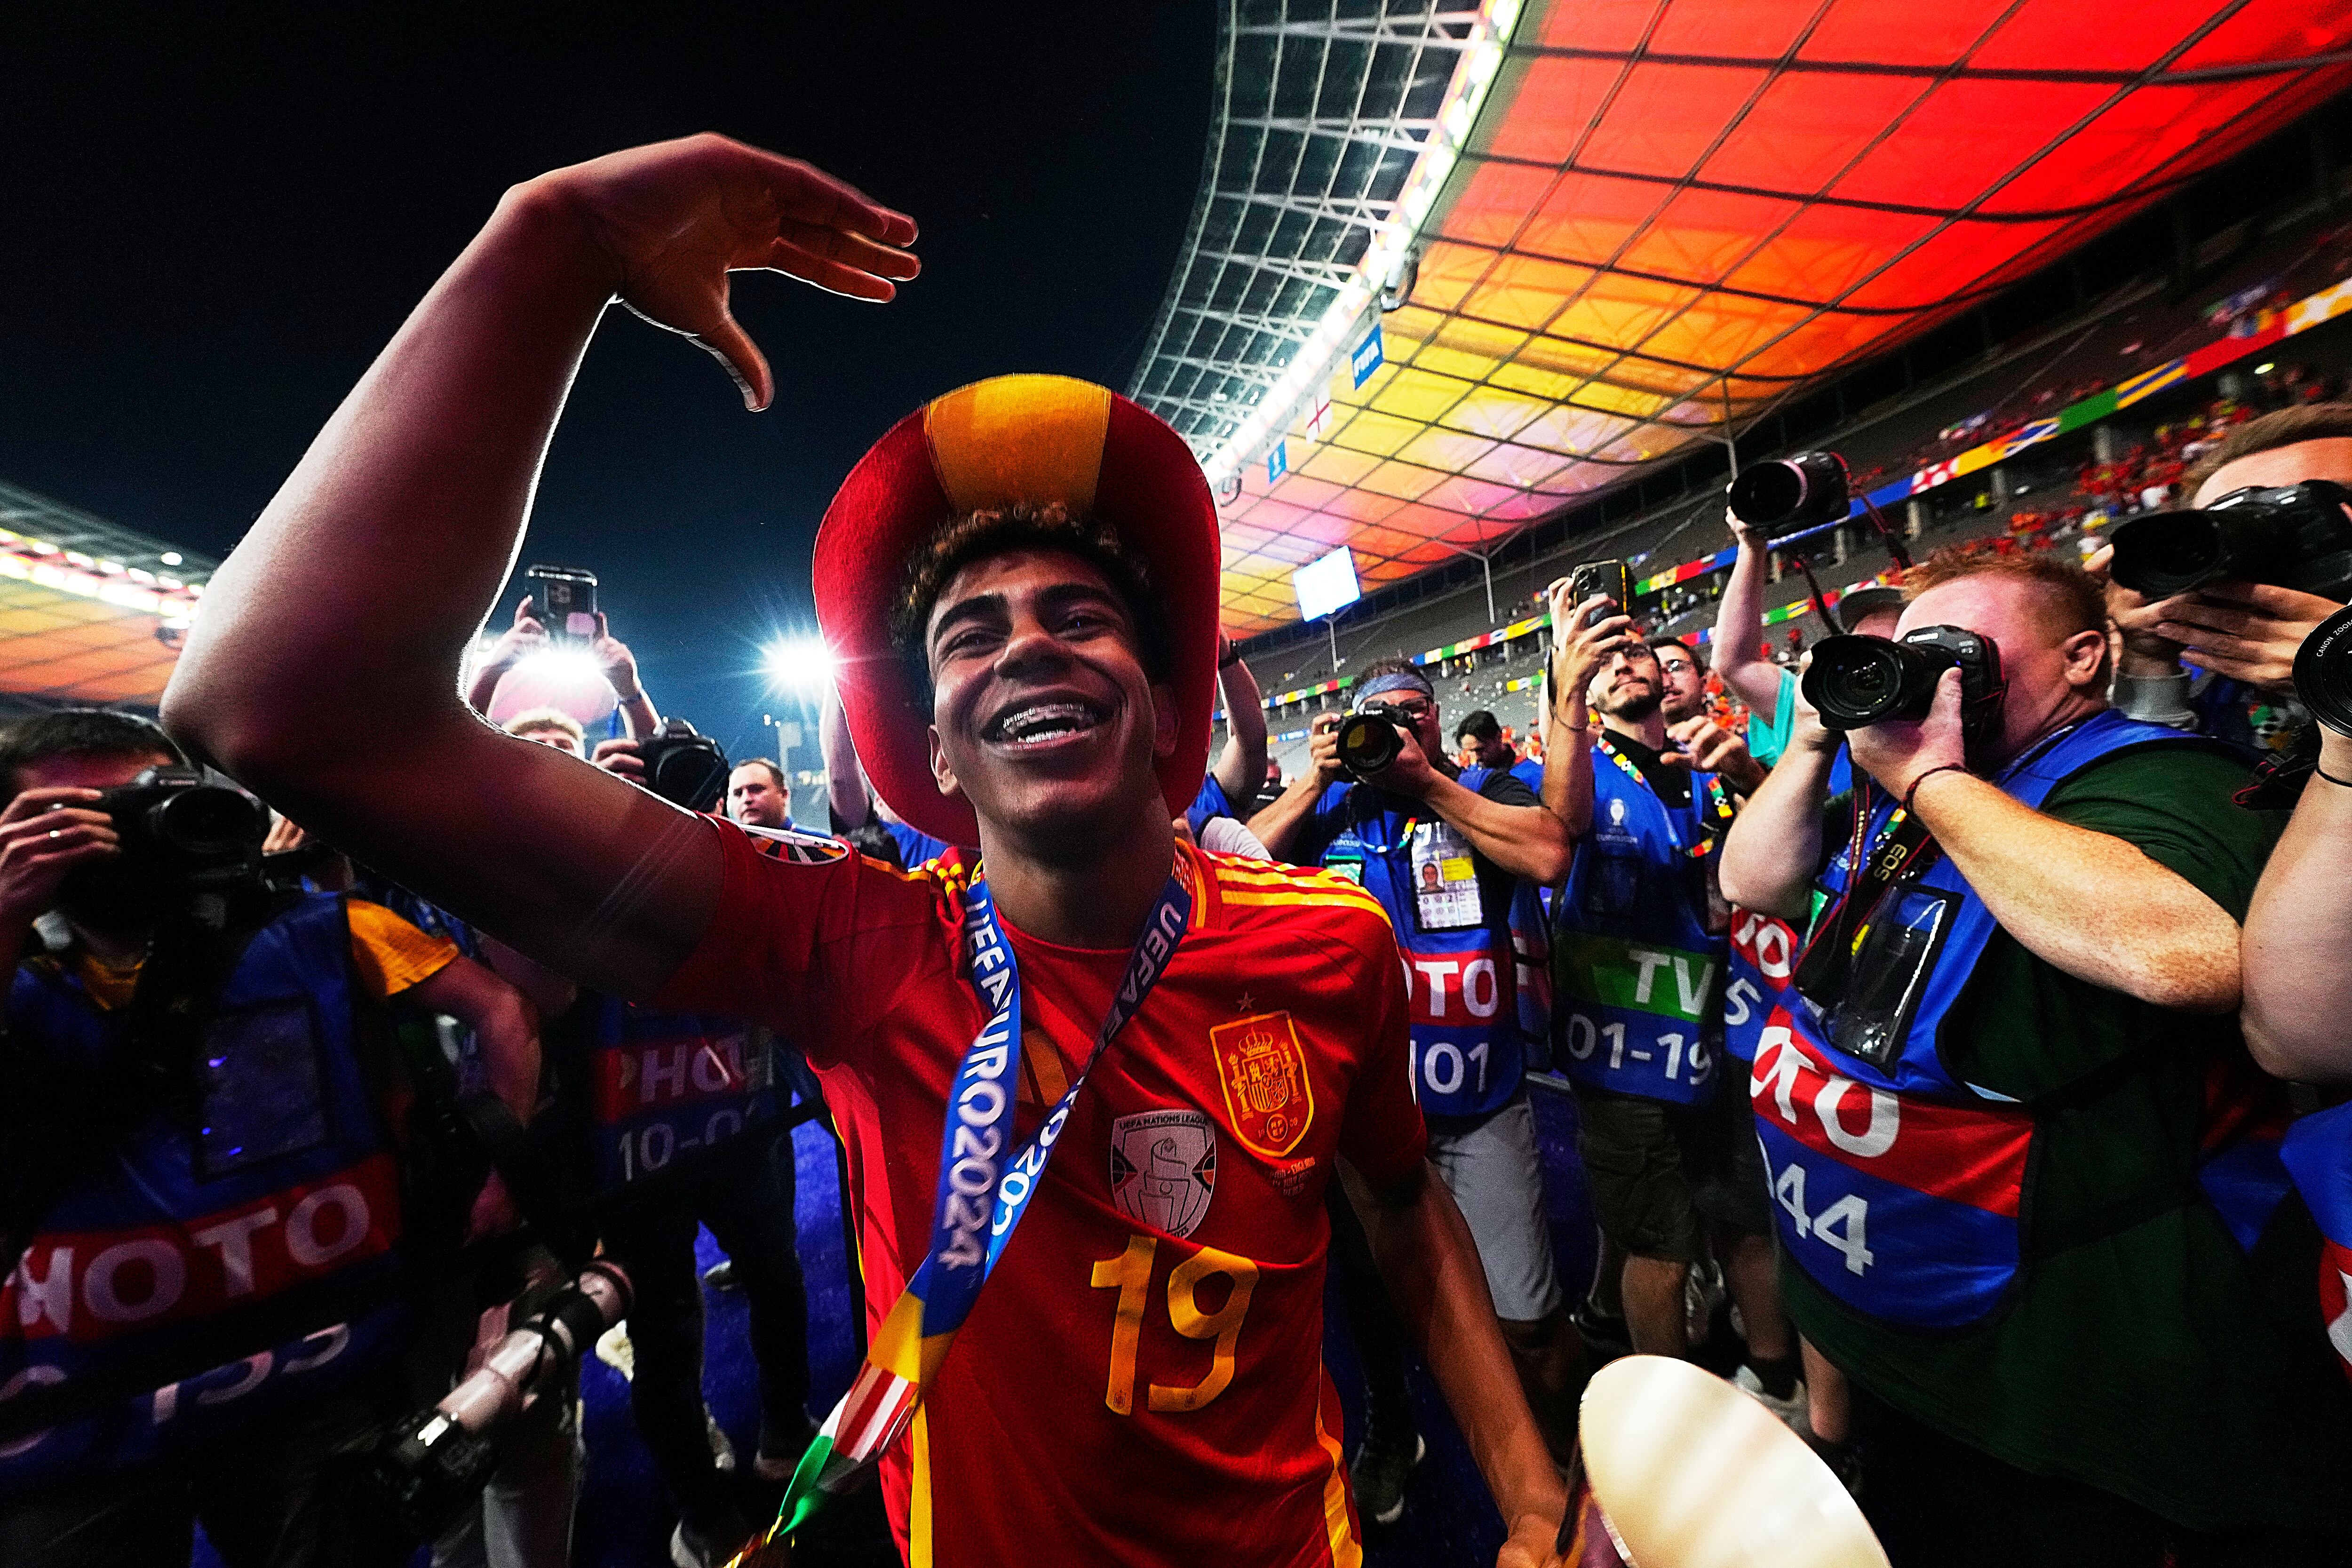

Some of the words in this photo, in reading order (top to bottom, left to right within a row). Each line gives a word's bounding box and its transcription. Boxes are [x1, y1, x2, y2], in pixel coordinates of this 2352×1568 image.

[2316, 636, 2334, 657] CANON
[1873, 844, 1908, 881] EOS
[1121, 901, 1182, 1004] UEFA
[1401, 958, 1499, 1017] TO
[1627, 948, 1716, 1016] TV
[939, 987, 1014, 1270] URO2024
[1144, 1114, 1180, 1125] NATIONS
[1756, 1129, 1874, 1277] 44
[2, 1184, 370, 1335] HOTO
[1090, 1235, 1260, 1416] 19
